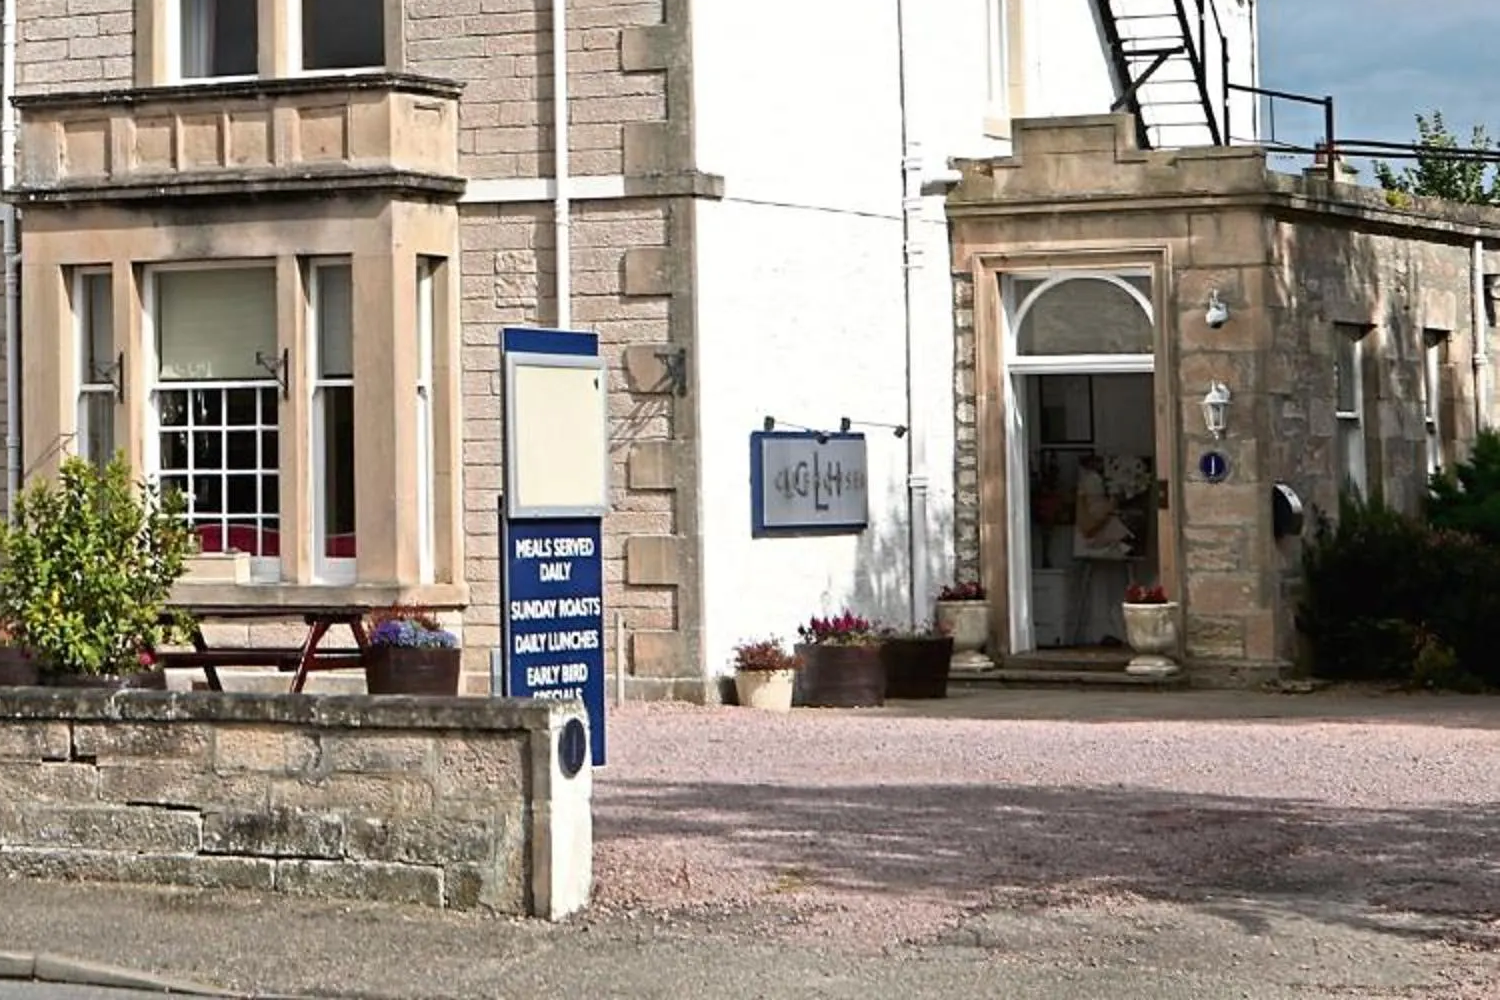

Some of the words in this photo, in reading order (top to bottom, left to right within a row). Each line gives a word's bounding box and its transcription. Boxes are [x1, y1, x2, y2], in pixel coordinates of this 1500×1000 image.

[515, 538, 553, 559] MEALS
[553, 537, 595, 557] SERVED
[539, 561, 572, 582] DAILY
[511, 599, 557, 621] SUNDAY
[558, 596, 601, 618] ROASTS
[515, 632, 547, 654] DAILY
[547, 629, 599, 652] LUNCHES
[526, 665, 560, 687] EARLY
[561, 662, 589, 683] BIRD
